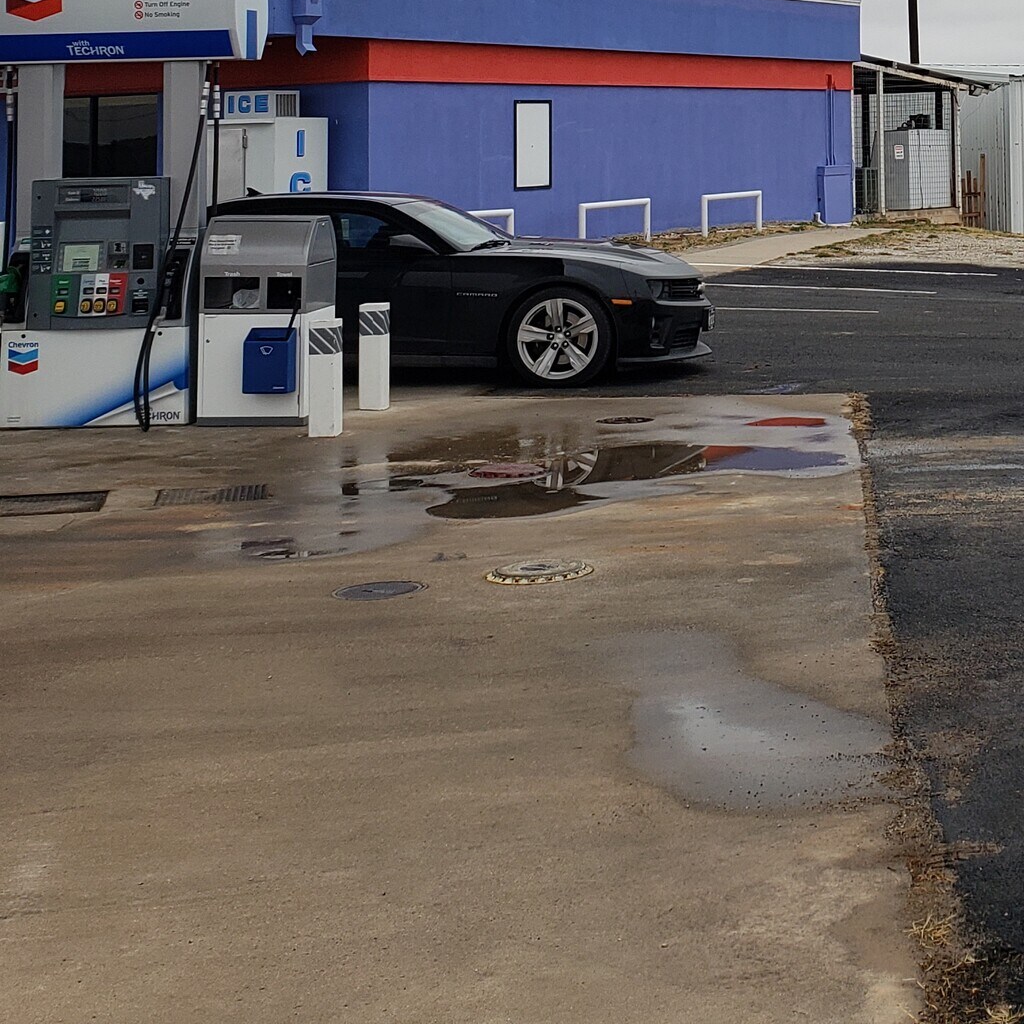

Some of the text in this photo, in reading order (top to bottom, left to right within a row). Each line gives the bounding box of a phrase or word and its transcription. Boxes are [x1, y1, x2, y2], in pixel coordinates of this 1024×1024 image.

[170, 0, 190, 9] Engine
[154, 11, 180, 19] Smoking
[66, 45, 125, 57] TECHRON
[227, 94, 269, 114] ICE
[289, 129, 312, 193] IC
